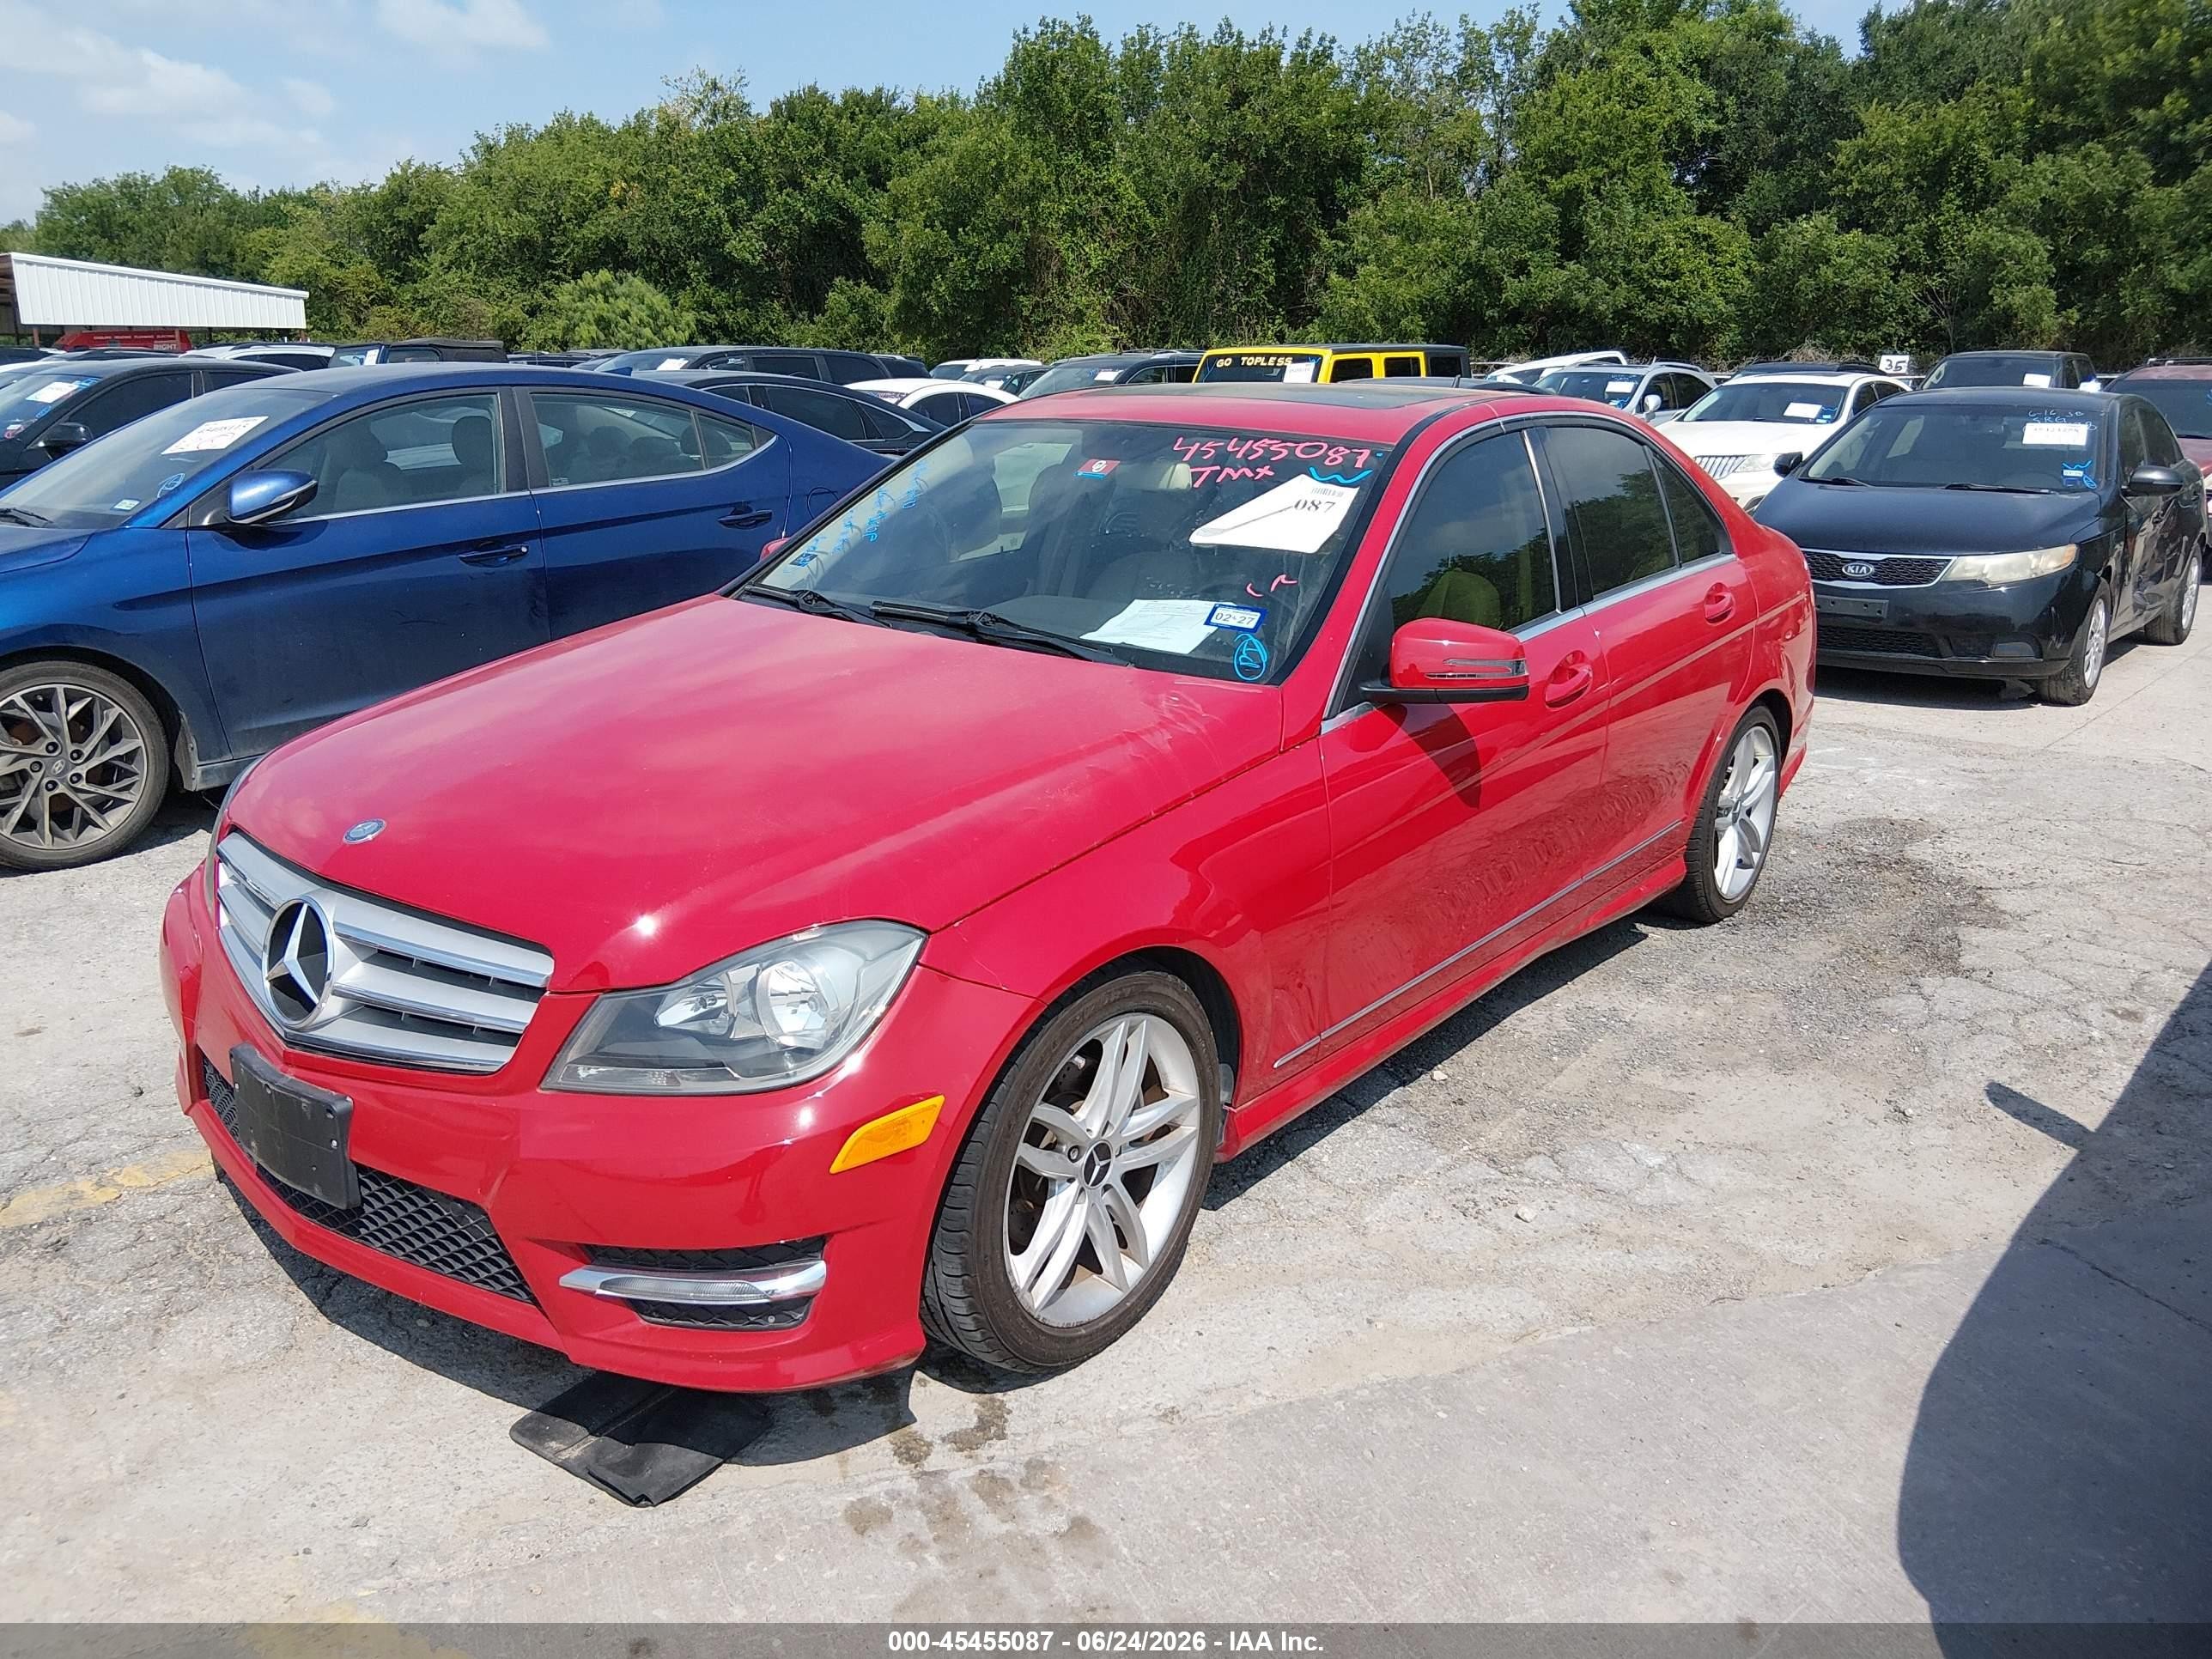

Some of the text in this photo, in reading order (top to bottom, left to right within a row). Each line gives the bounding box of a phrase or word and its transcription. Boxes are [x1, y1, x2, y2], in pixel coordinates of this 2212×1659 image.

[1216, 356, 1292, 368] GO TOPLESS
[1884, 358, 1906, 372] 35
[1173, 436, 1372, 469] 45455087
[1294, 499, 1336, 514] 087
[1847, 565, 1867, 574] KIA
